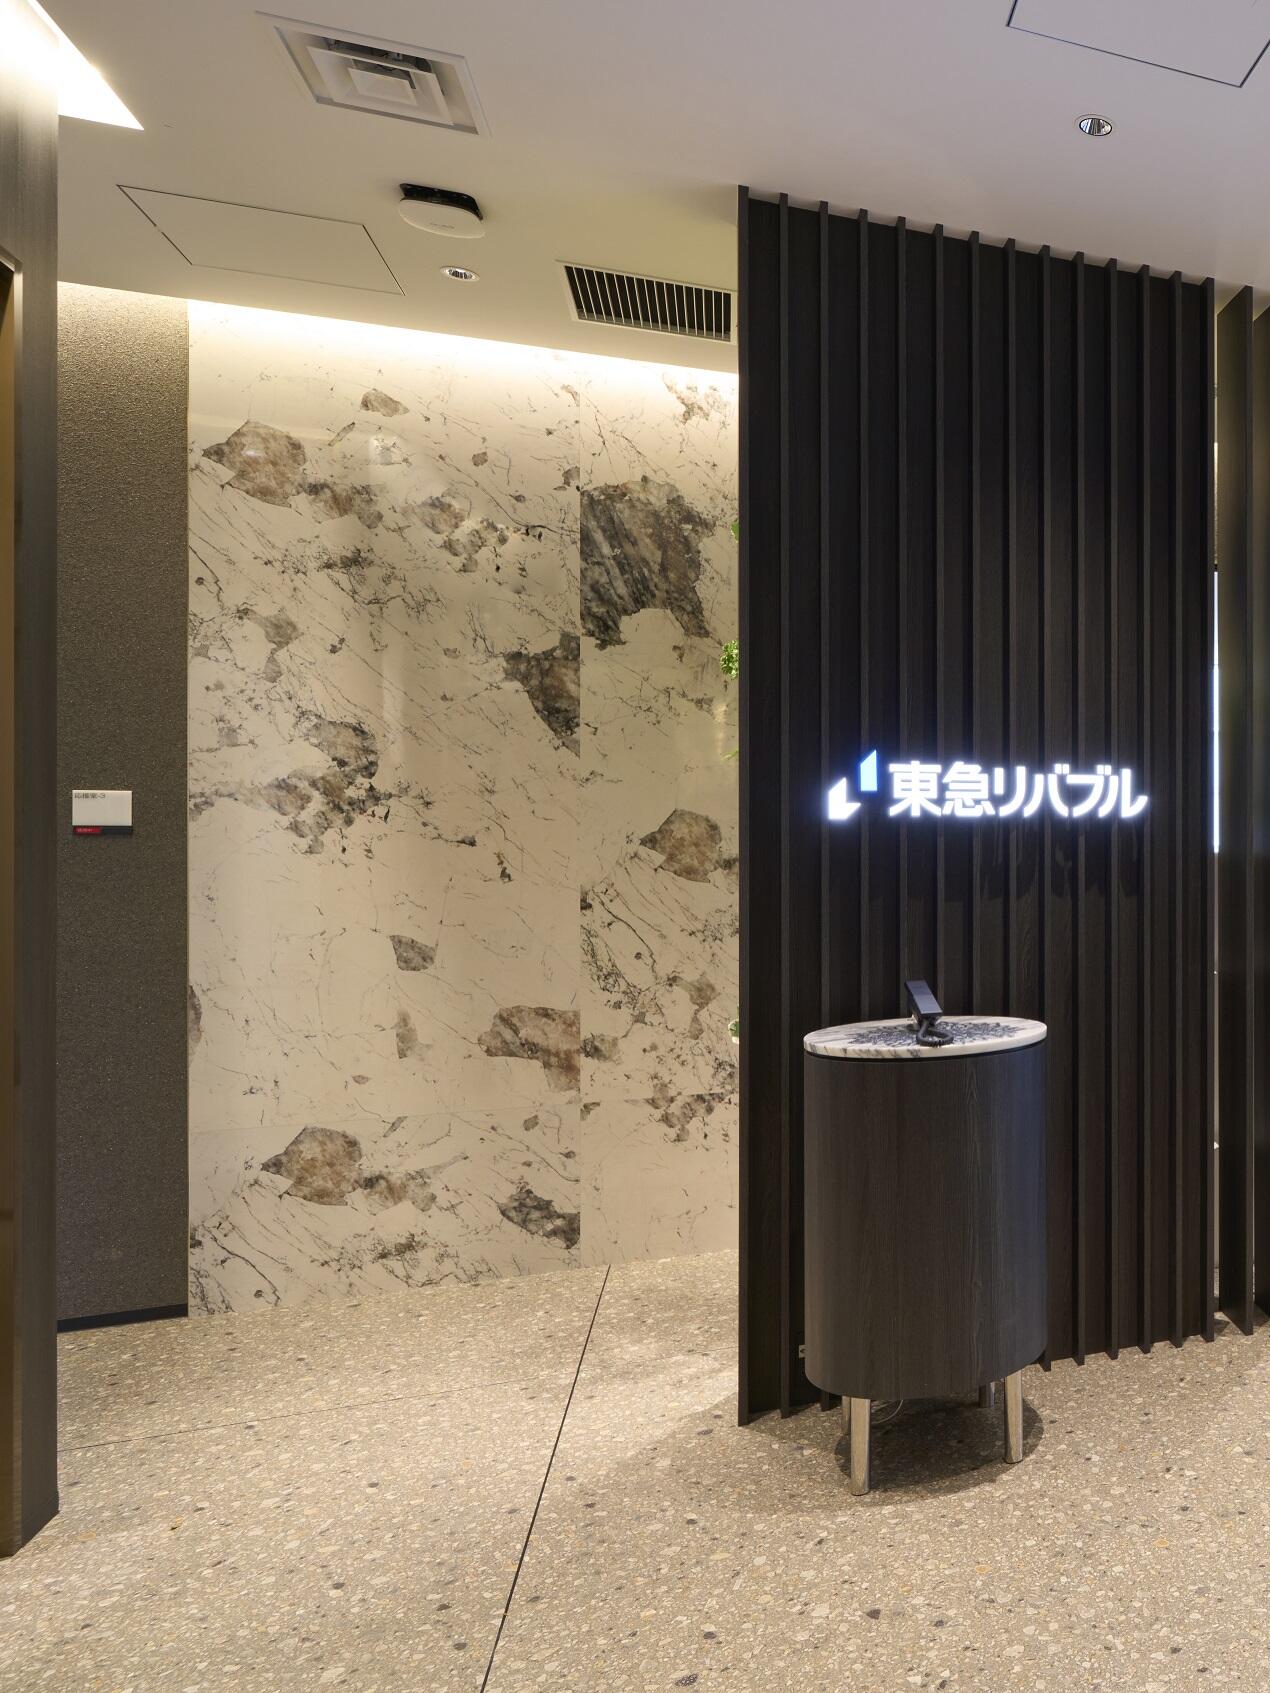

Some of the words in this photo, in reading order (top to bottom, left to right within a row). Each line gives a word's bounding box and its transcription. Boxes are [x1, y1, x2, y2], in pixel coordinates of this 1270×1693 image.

[888, 760, 1149, 819] 東急リバブル
